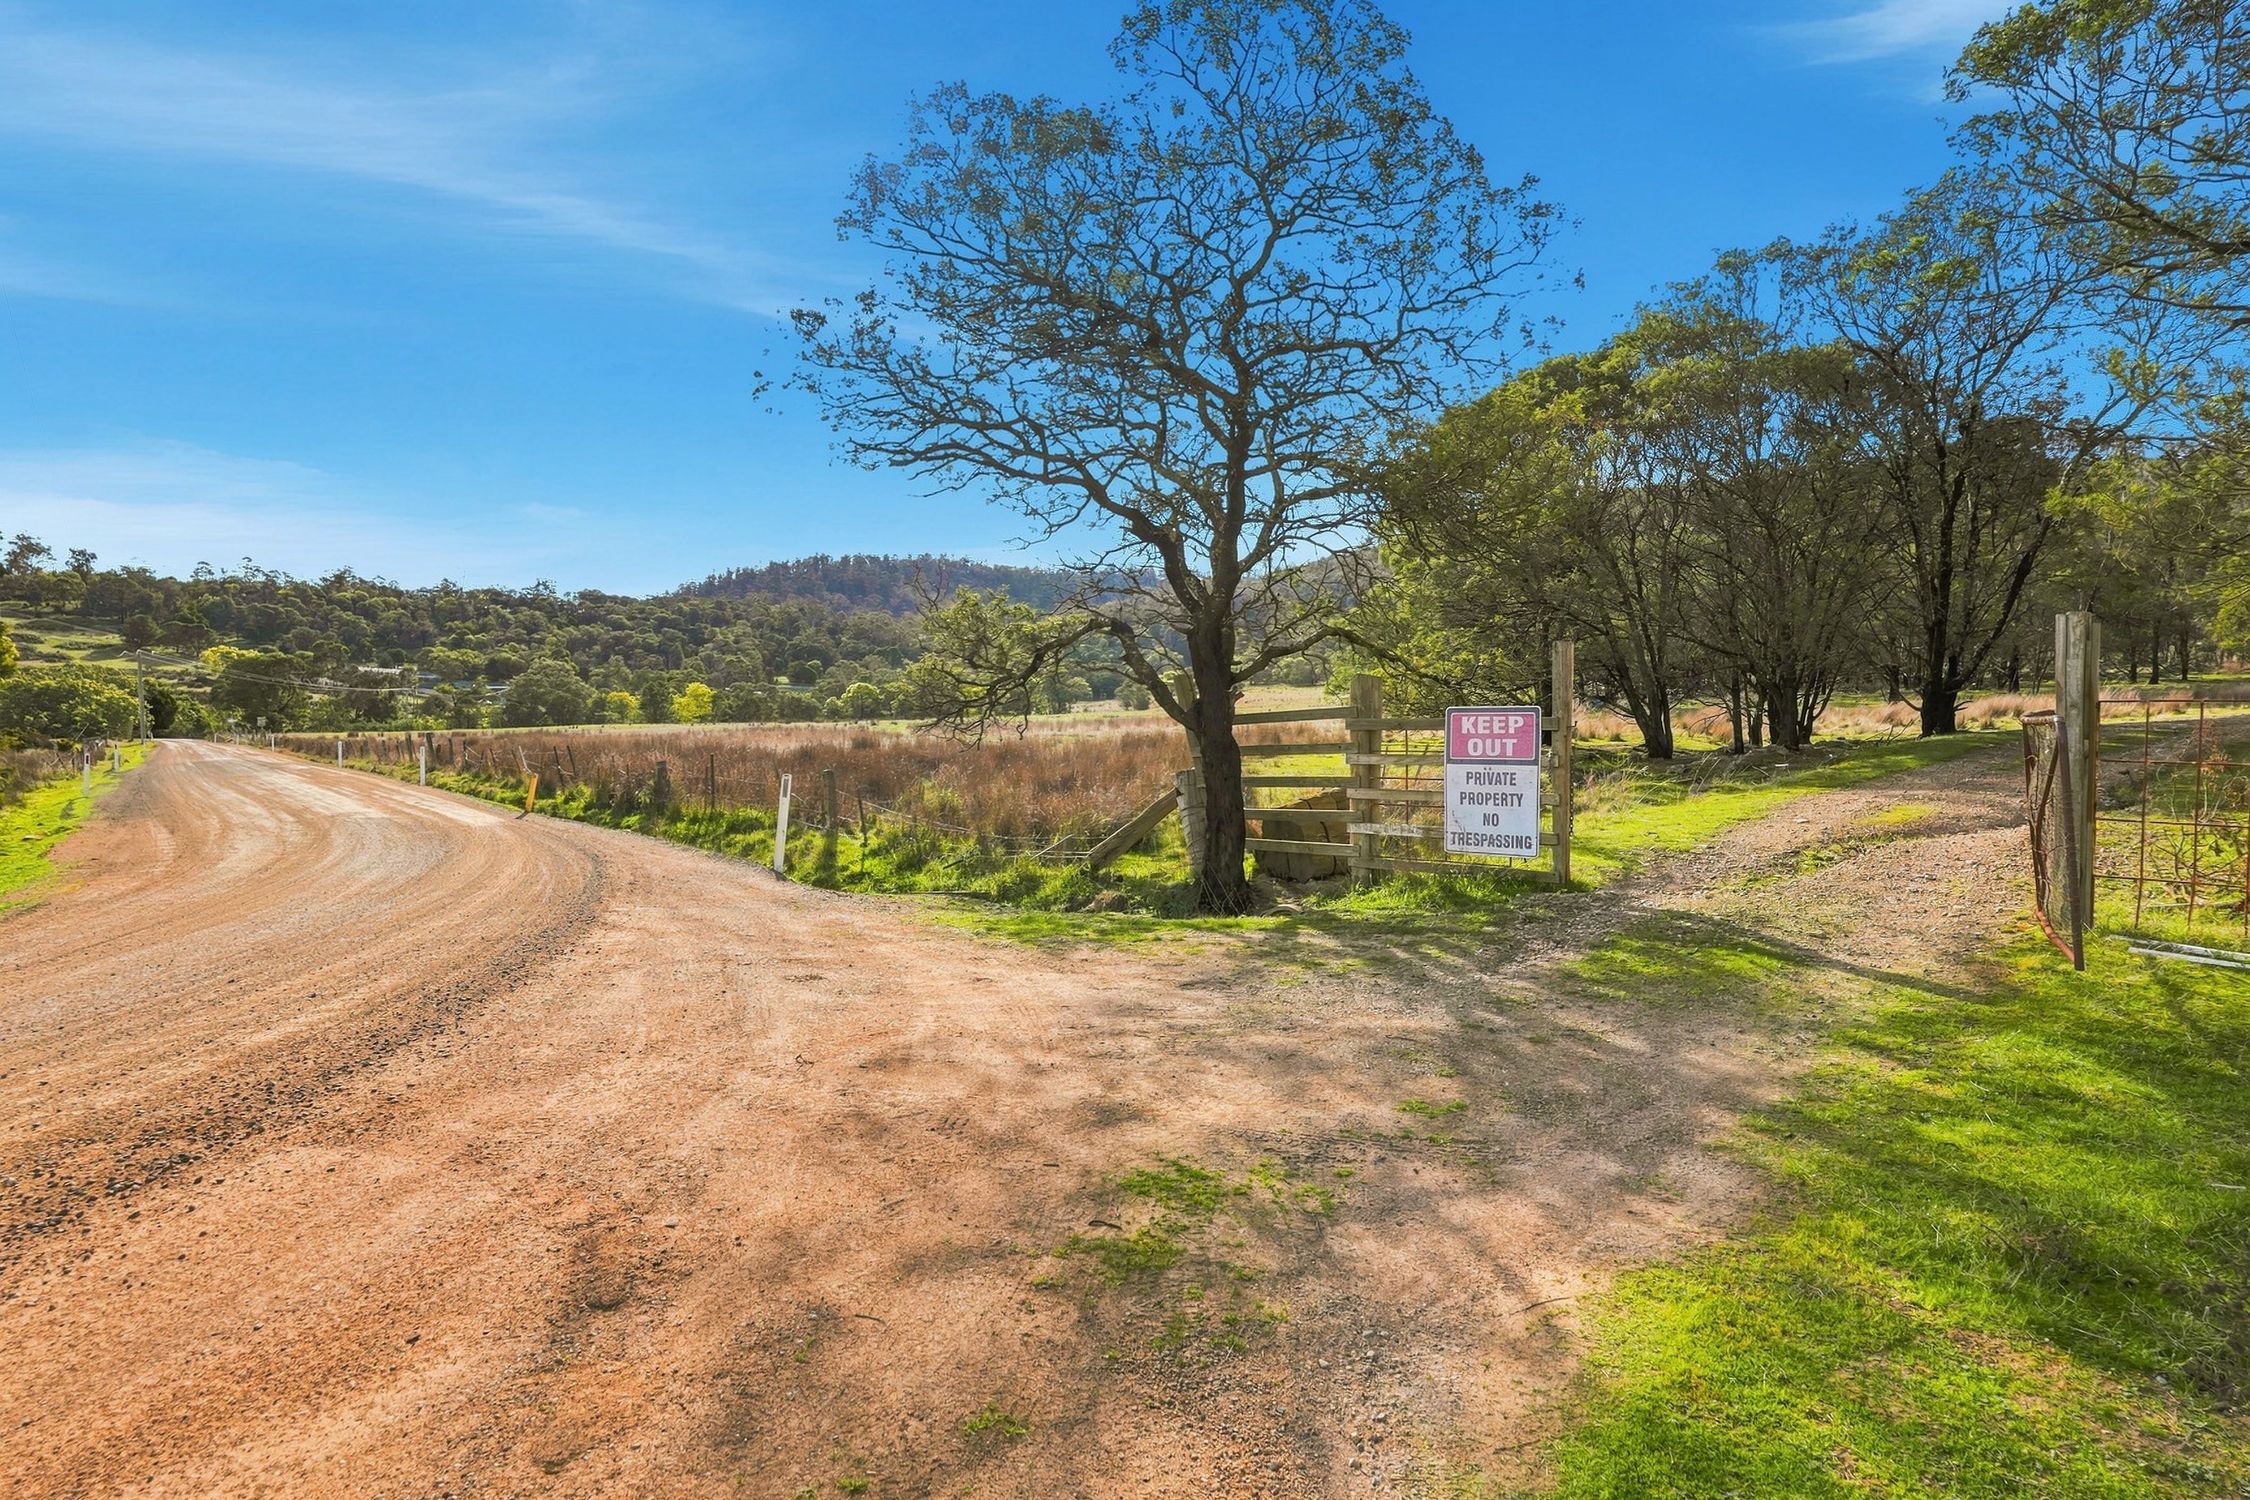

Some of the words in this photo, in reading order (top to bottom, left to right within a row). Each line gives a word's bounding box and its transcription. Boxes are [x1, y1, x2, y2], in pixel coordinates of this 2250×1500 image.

[1461, 716, 1524, 734] KEEP
[1468, 738, 1518, 756] OUT
[1466, 771, 1517, 786] PRIVATE
[1460, 792, 1523, 807] PROPERTY
[1483, 813, 1499, 827] NO
[1450, 832, 1532, 849] TRESPASSING
